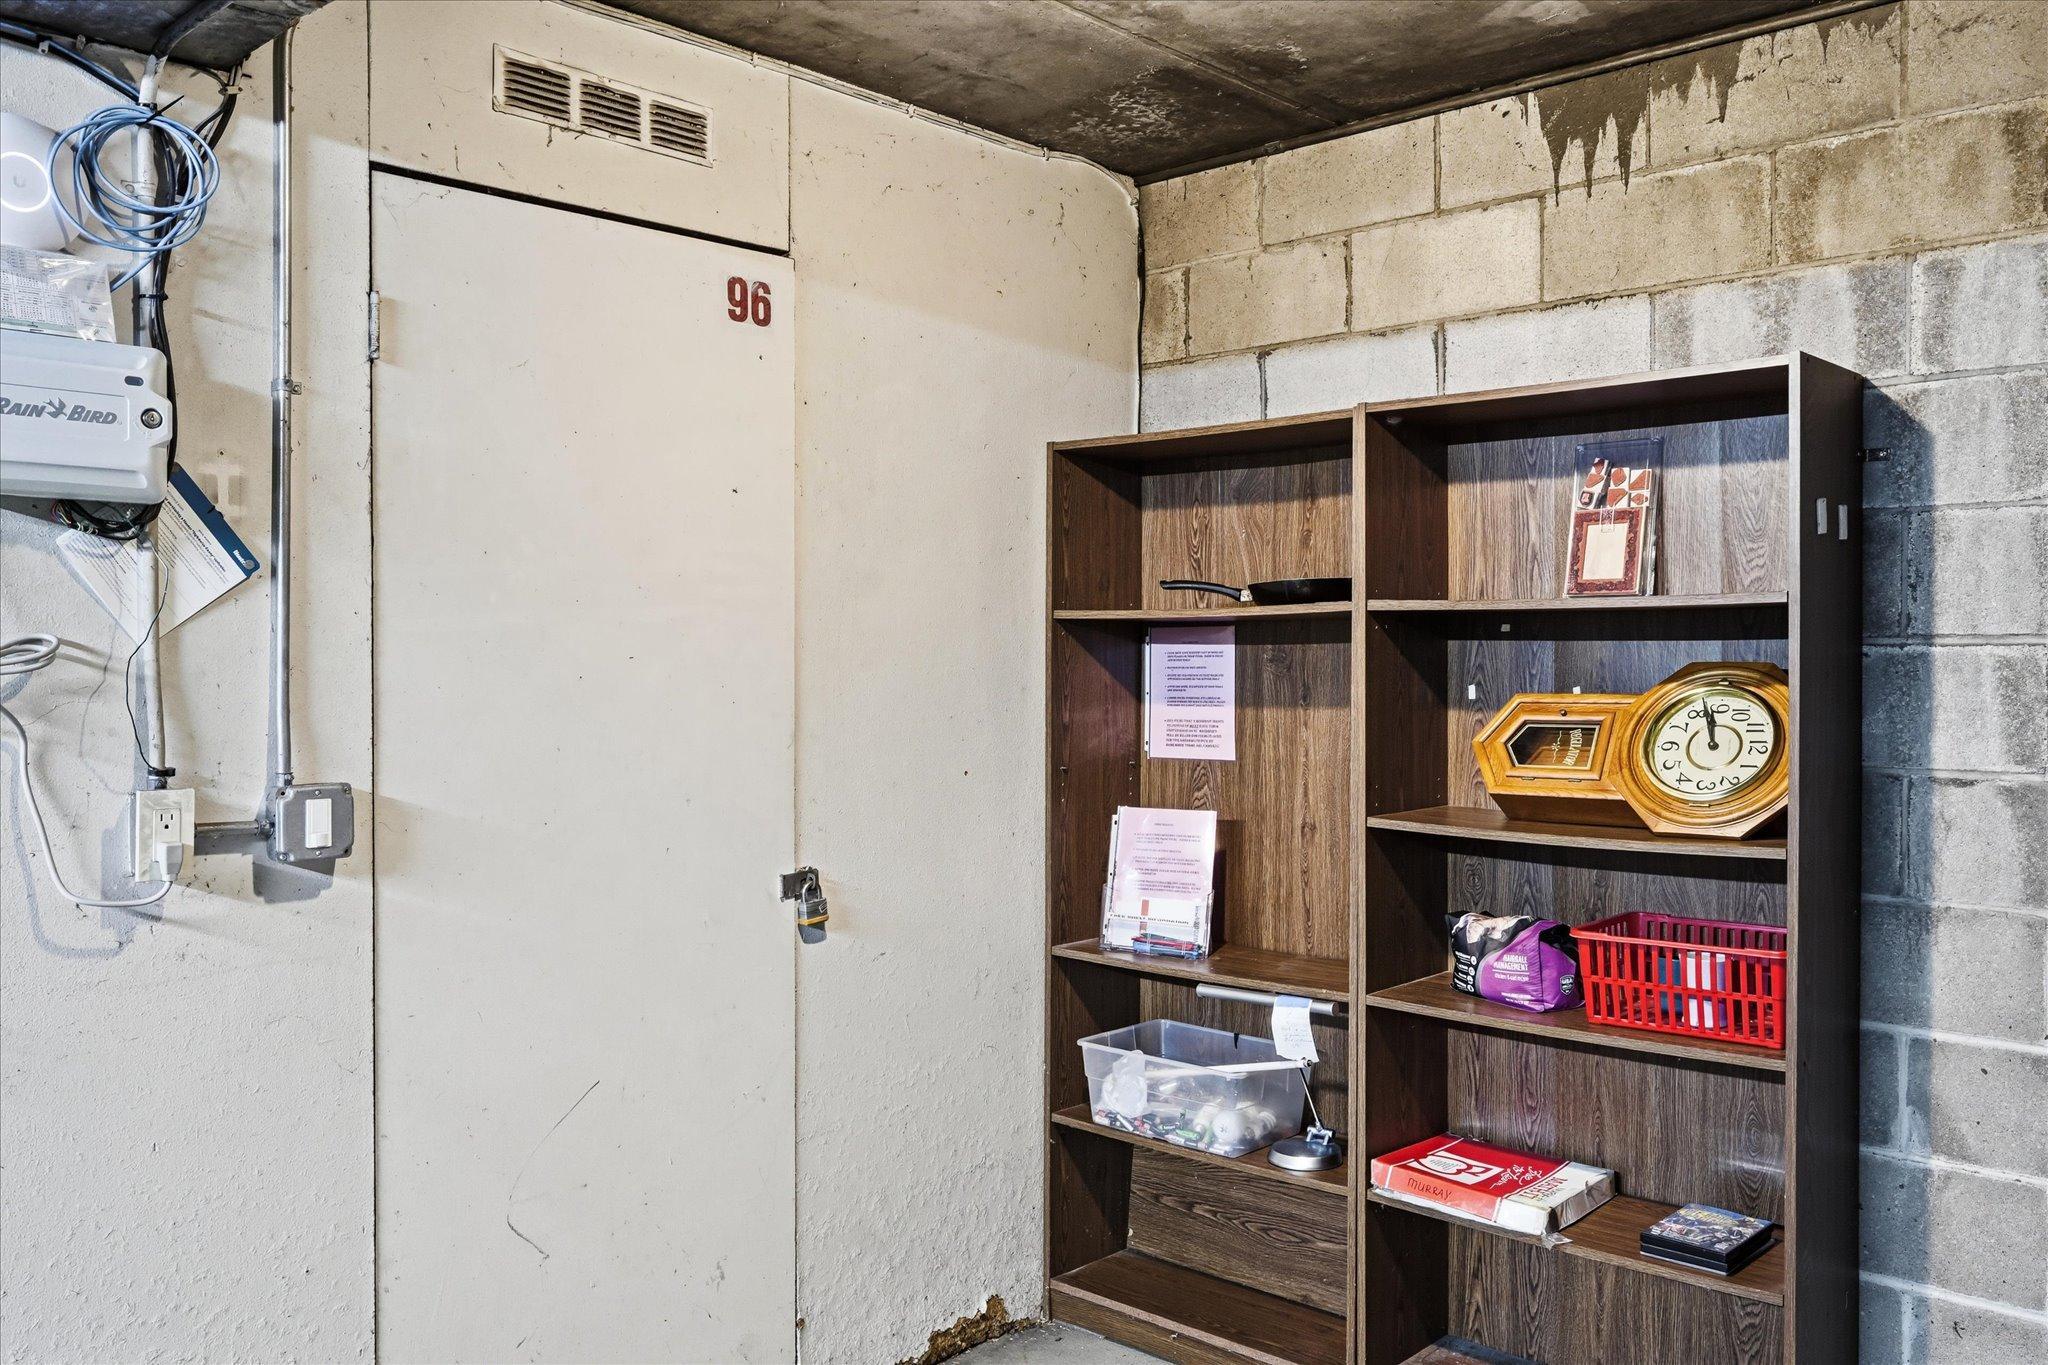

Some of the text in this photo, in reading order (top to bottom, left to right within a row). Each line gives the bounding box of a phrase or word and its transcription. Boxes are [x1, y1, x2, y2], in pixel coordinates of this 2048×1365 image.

[727, 276, 771, 327] 96
[66, 404, 118, 425] BIRD
[1688, 709, 1707, 719] 8
[1710, 703, 1730, 715] 9
[1731, 708, 1750, 722] 10
[1669, 722, 1689, 734] 7
[1746, 723, 1765, 733] 11
[1660, 740, 1680, 751] 6
[1748, 740, 1768, 755] 12
[1663, 759, 1682, 771] 5
[1675, 772, 1694, 785] 4
[1720, 776, 1740, 787] 2
[1696, 779, 1716, 791] 3
[1493, 961, 1528, 971] MANAGEMENT
[1407, 1177, 1453, 1200] MURRAY
